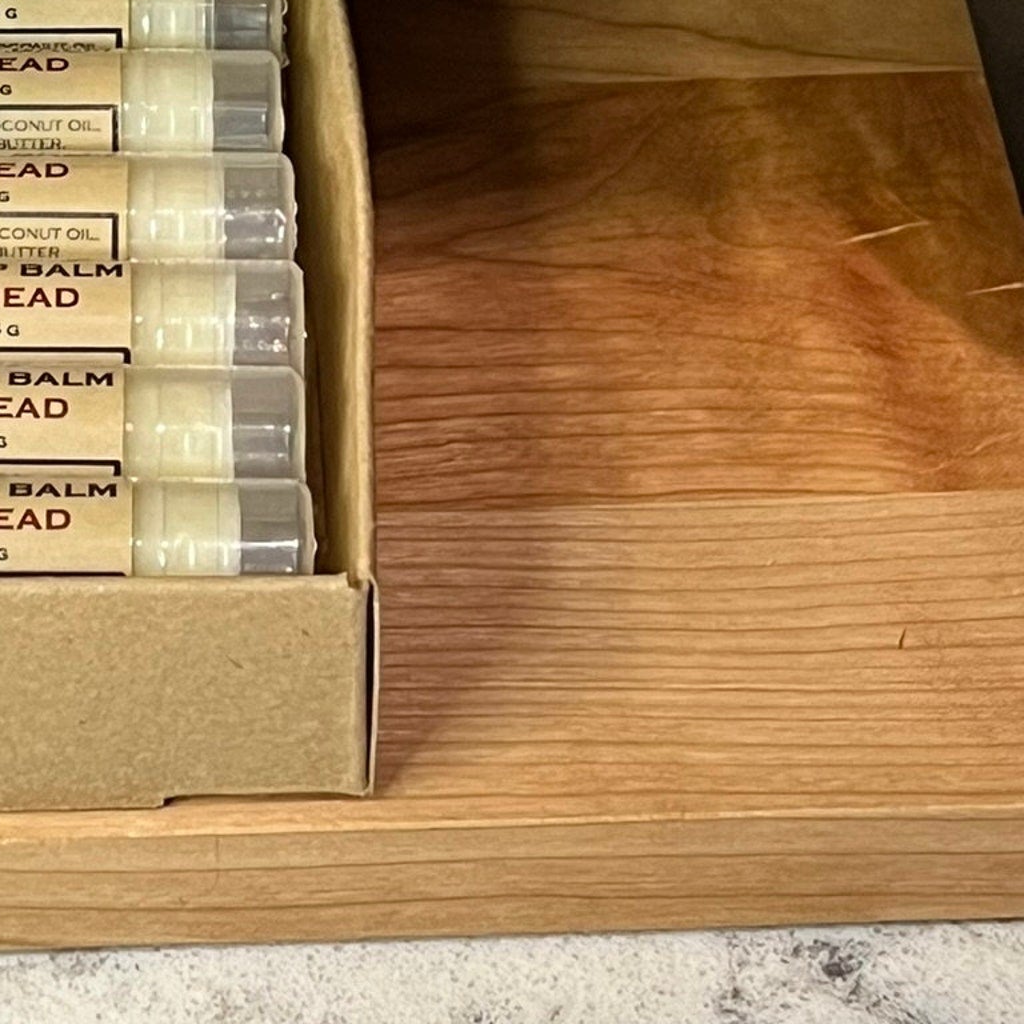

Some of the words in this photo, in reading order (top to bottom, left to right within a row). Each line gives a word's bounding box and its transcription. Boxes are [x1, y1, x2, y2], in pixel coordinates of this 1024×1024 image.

[20, 263, 123, 276] BALM
[7, 371, 114, 386] BALM
[7, 483, 118, 498] BALM
